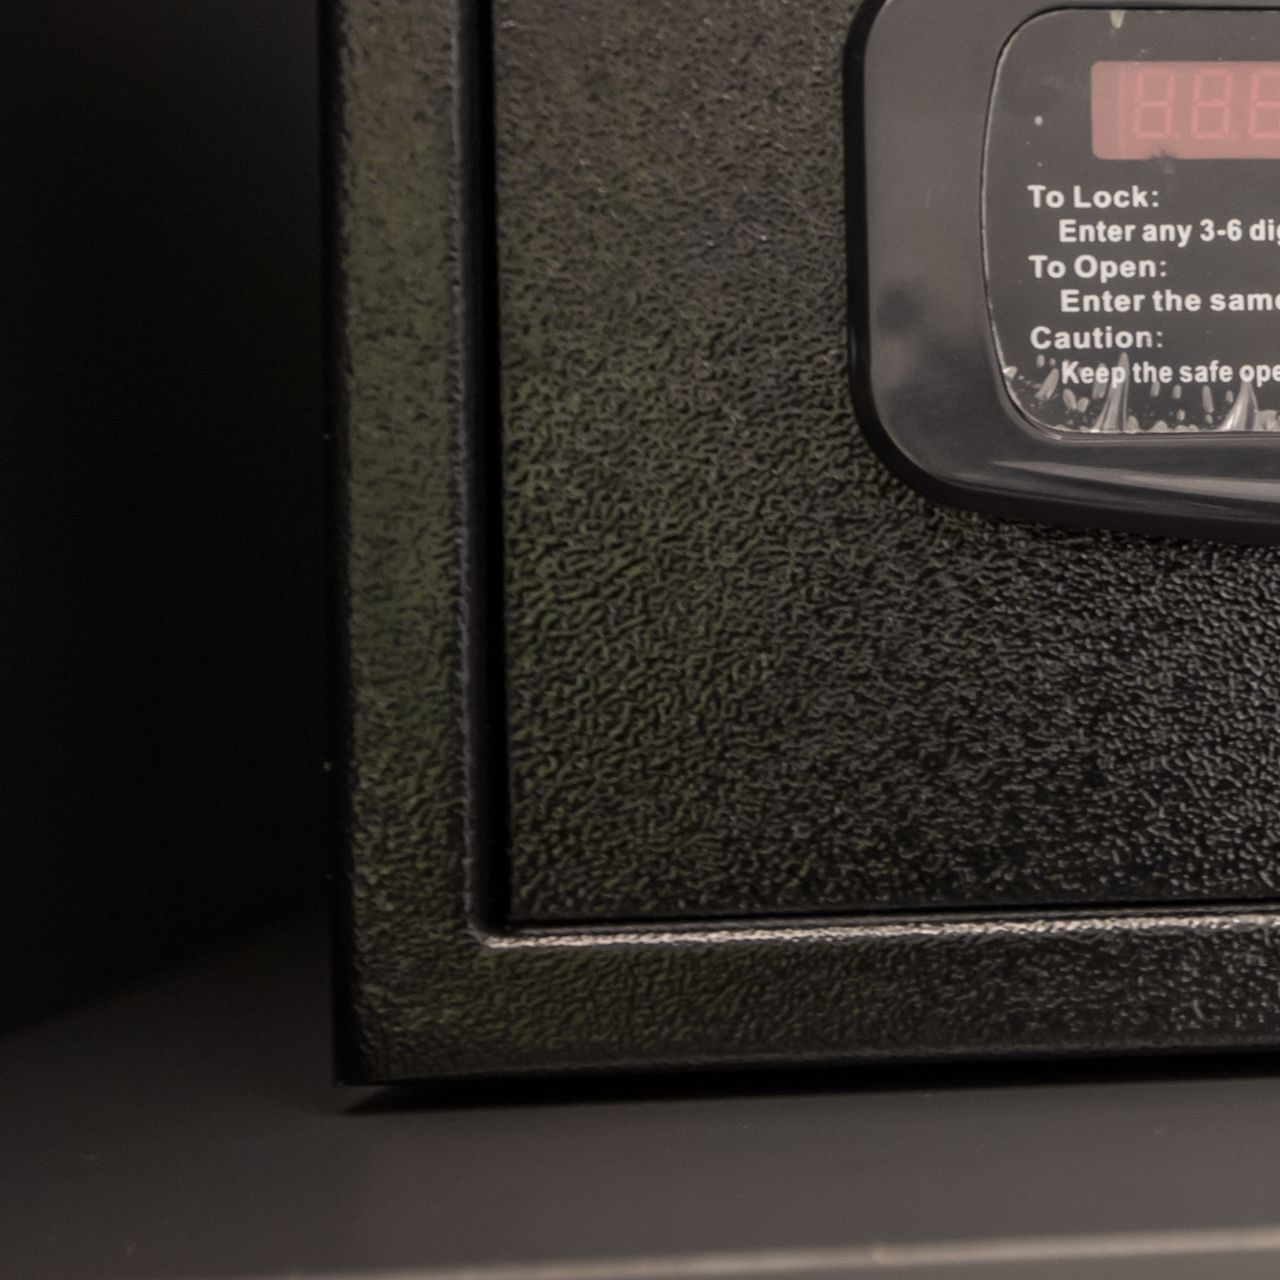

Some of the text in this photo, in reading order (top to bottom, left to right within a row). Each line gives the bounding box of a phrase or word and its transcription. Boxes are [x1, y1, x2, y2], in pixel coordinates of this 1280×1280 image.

[1026, 184, 1159, 209] To Lock:
[1058, 218, 1137, 243] Enter
[1142, 223, 1193, 248] any
[1199, 218, 1243, 242] 3-6
[1027, 254, 1167, 284] To Open:
[1060, 288, 1146, 313] Enter
[1151, 288, 1202, 312] the
[1030, 325, 1163, 350] Caution:
[1061, 360, 1126, 388] Keep
[1132, 360, 1172, 383] the
[1179, 359, 1234, 383] safe
